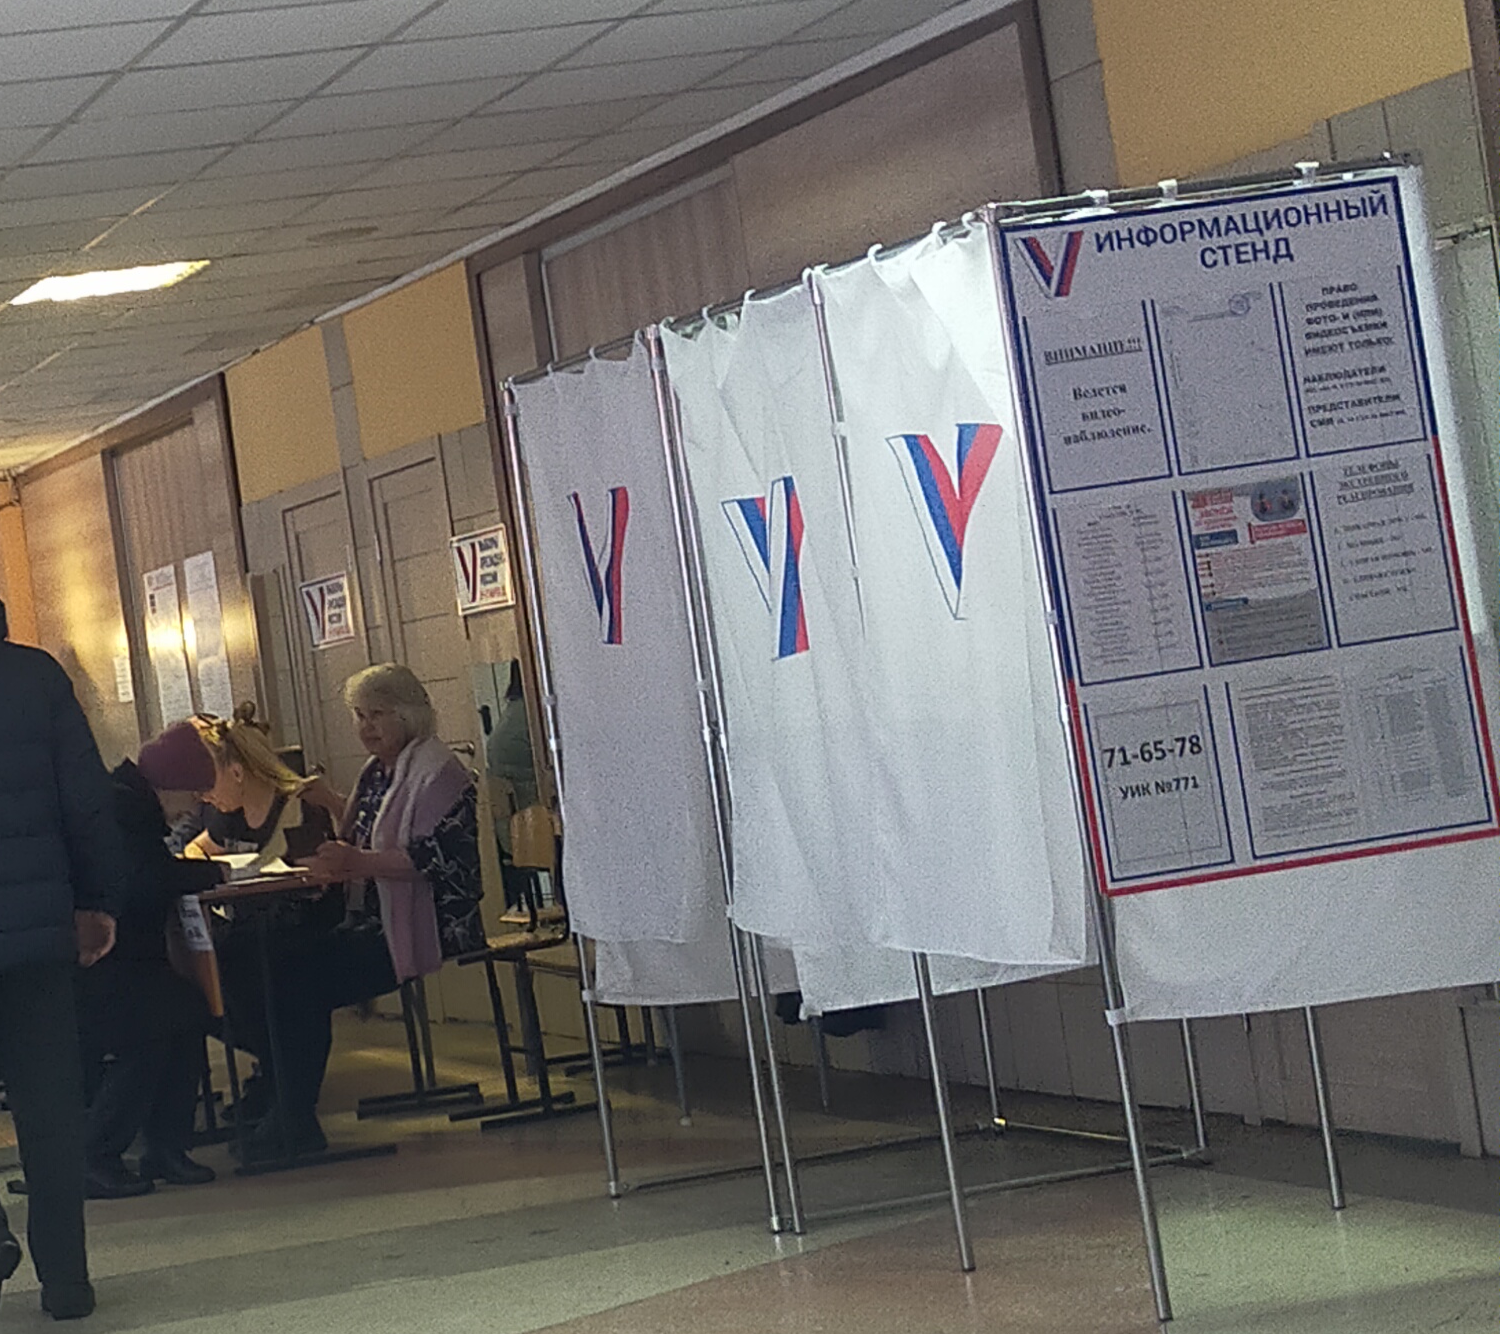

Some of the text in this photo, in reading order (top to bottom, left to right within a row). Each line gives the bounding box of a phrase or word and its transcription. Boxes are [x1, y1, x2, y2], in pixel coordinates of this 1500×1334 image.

[1095, 189, 1388, 253] ИНФОРМАЦИОННЫЙ
[1200, 237, 1294, 269] СТЕНД
[1102, 734, 1202, 768] 71-65-78
[1120, 775, 1199, 800] УИК №771
